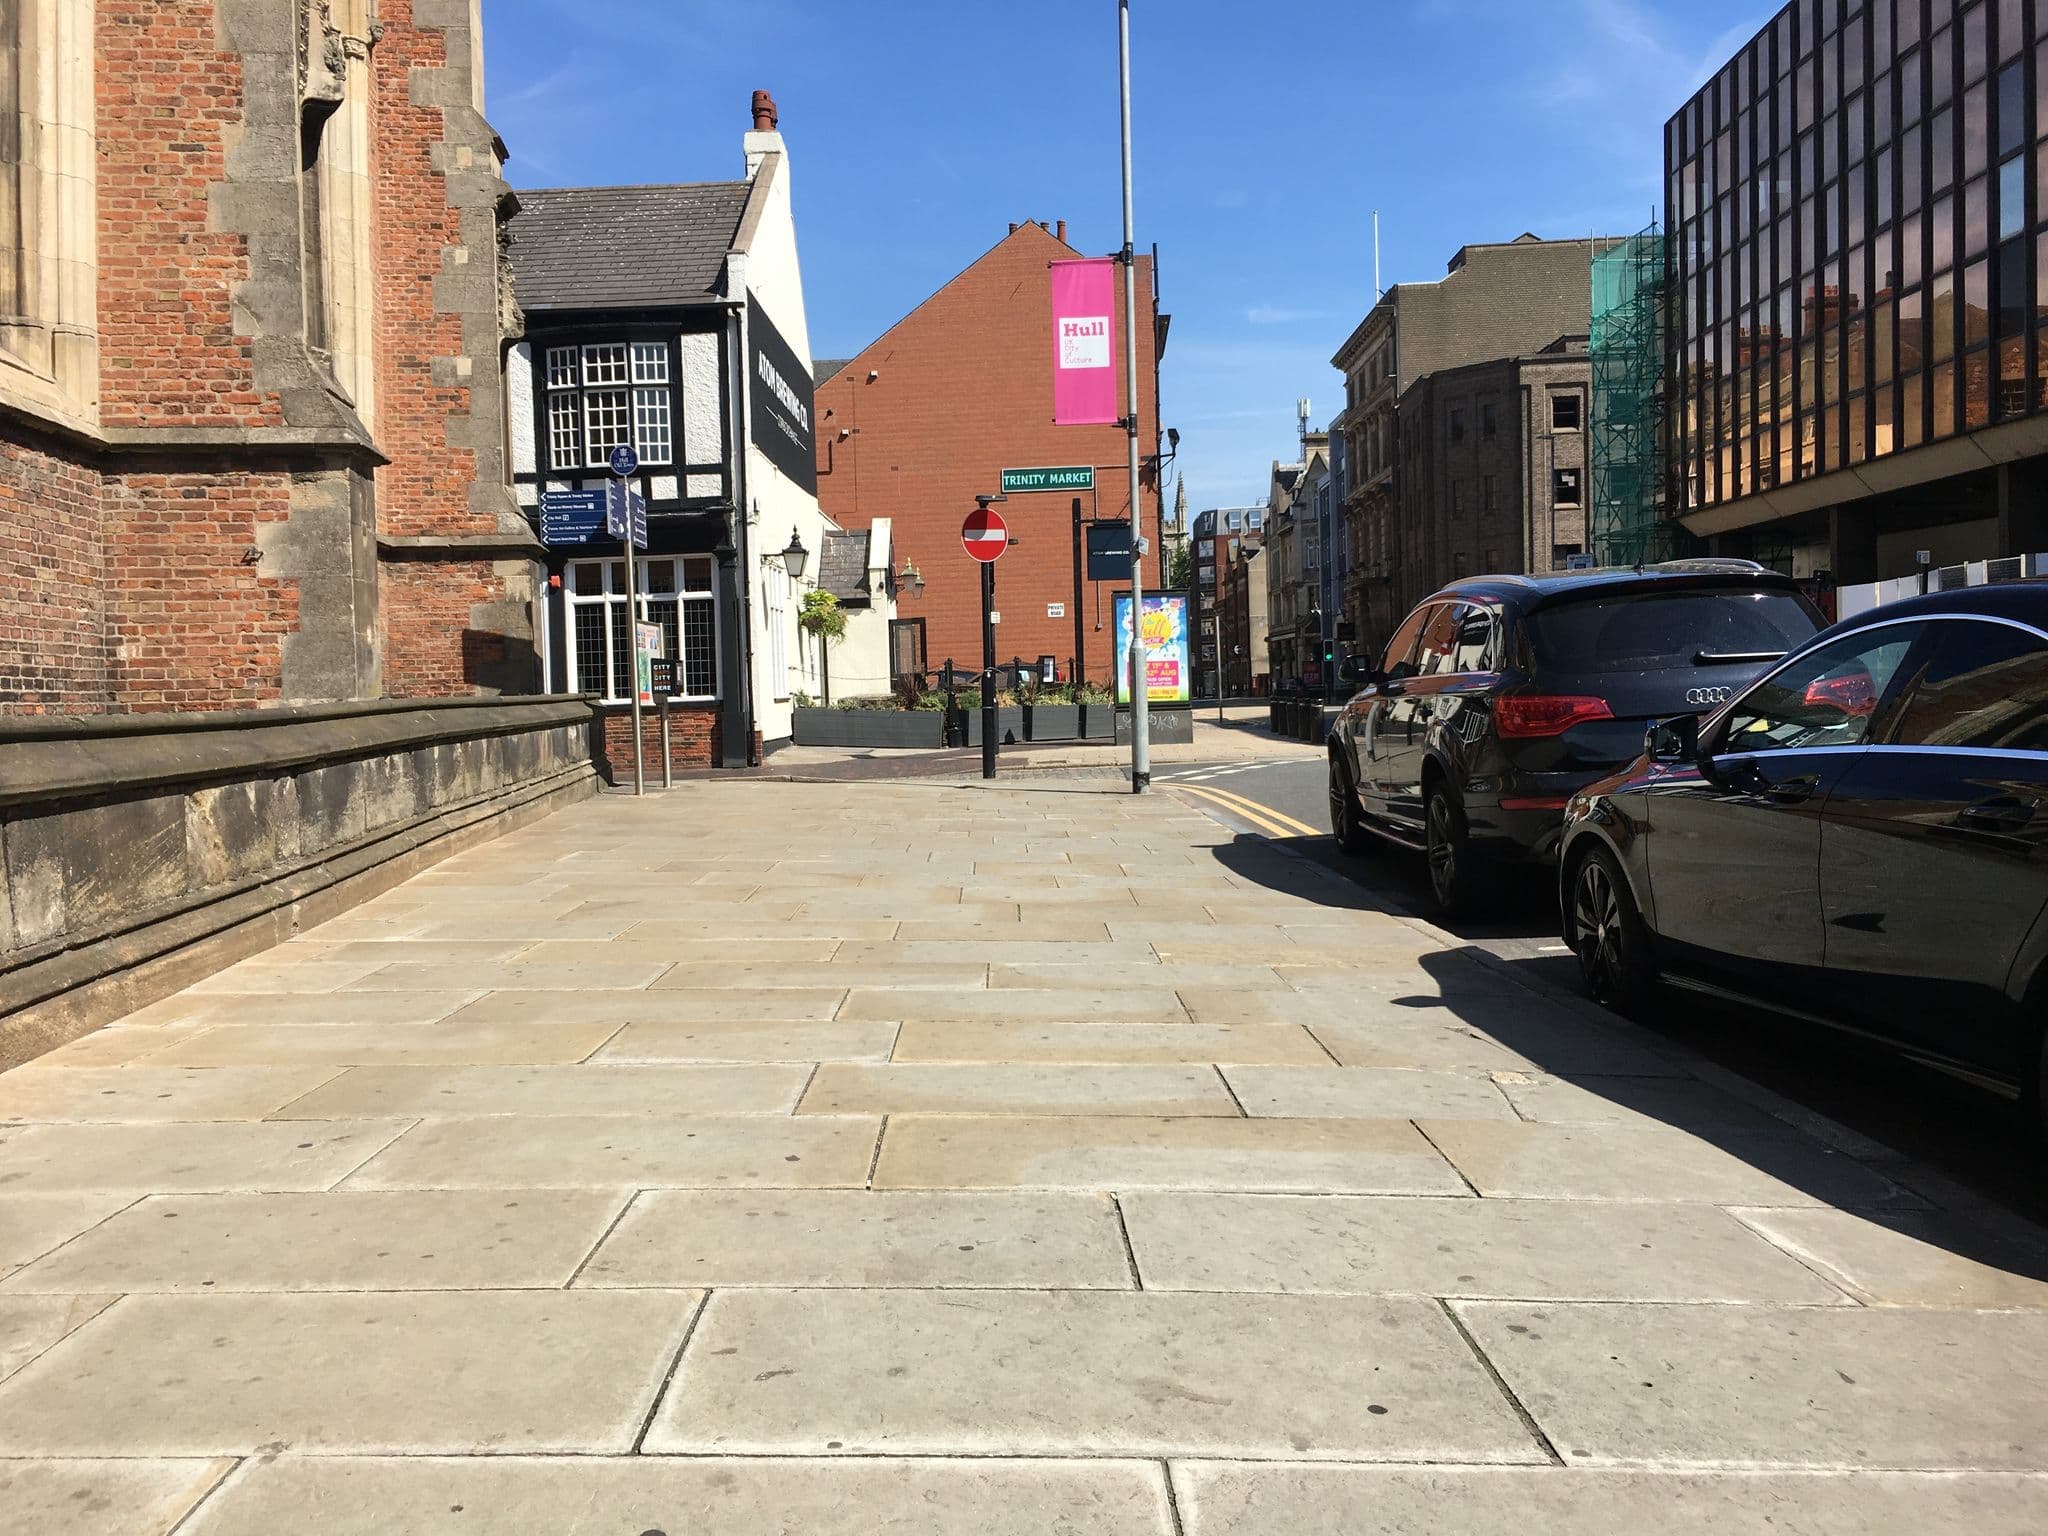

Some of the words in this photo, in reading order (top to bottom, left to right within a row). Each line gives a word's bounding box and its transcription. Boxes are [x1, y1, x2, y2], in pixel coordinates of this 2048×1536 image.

[1063, 322, 1105, 337] Hull
[1064, 357, 1093, 365] Culture
[758, 349, 776, 394] ATOM
[775, 370, 800, 423] BREWING
[1003, 474, 1045, 486] TRINITY
[1049, 472, 1091, 484] MARKET
